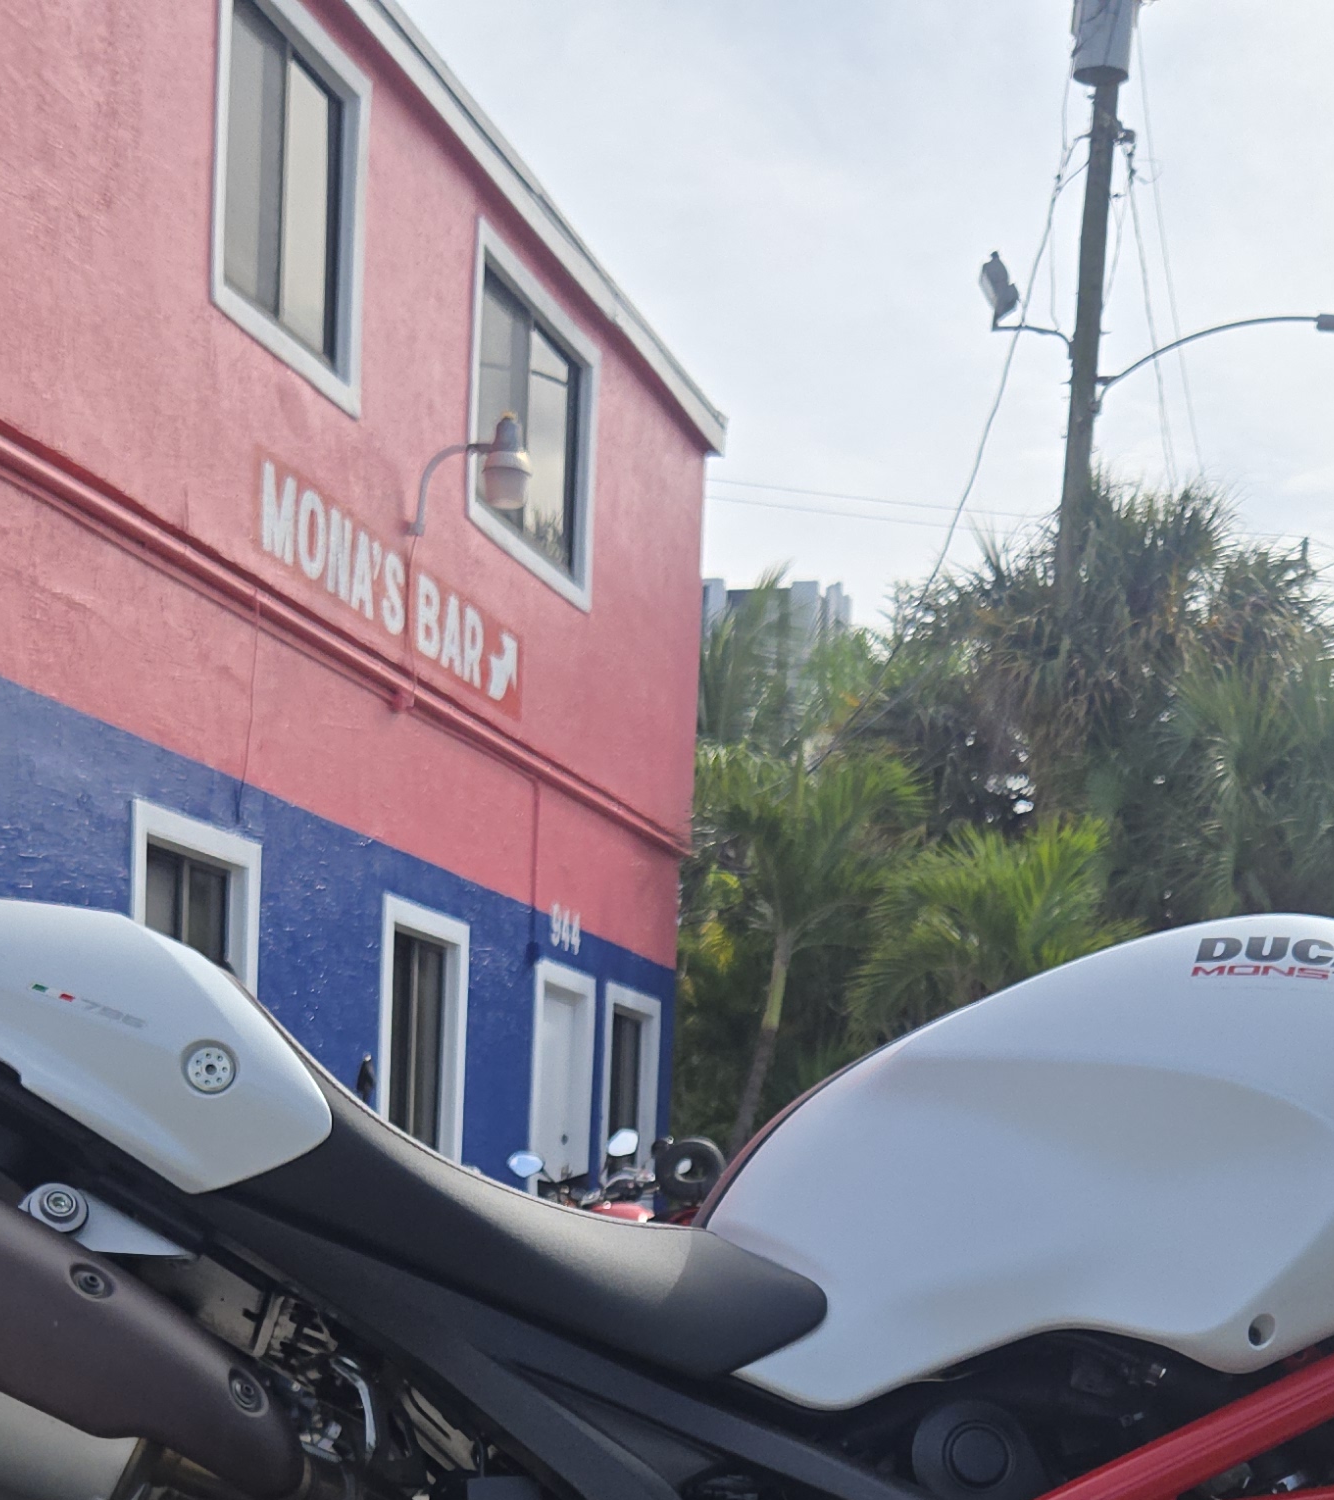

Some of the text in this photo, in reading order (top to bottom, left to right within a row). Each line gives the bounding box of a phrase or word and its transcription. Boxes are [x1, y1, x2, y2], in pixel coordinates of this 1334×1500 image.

[261, 459, 484, 690] MONA'S BAR
[550, 902, 582, 956] 944
